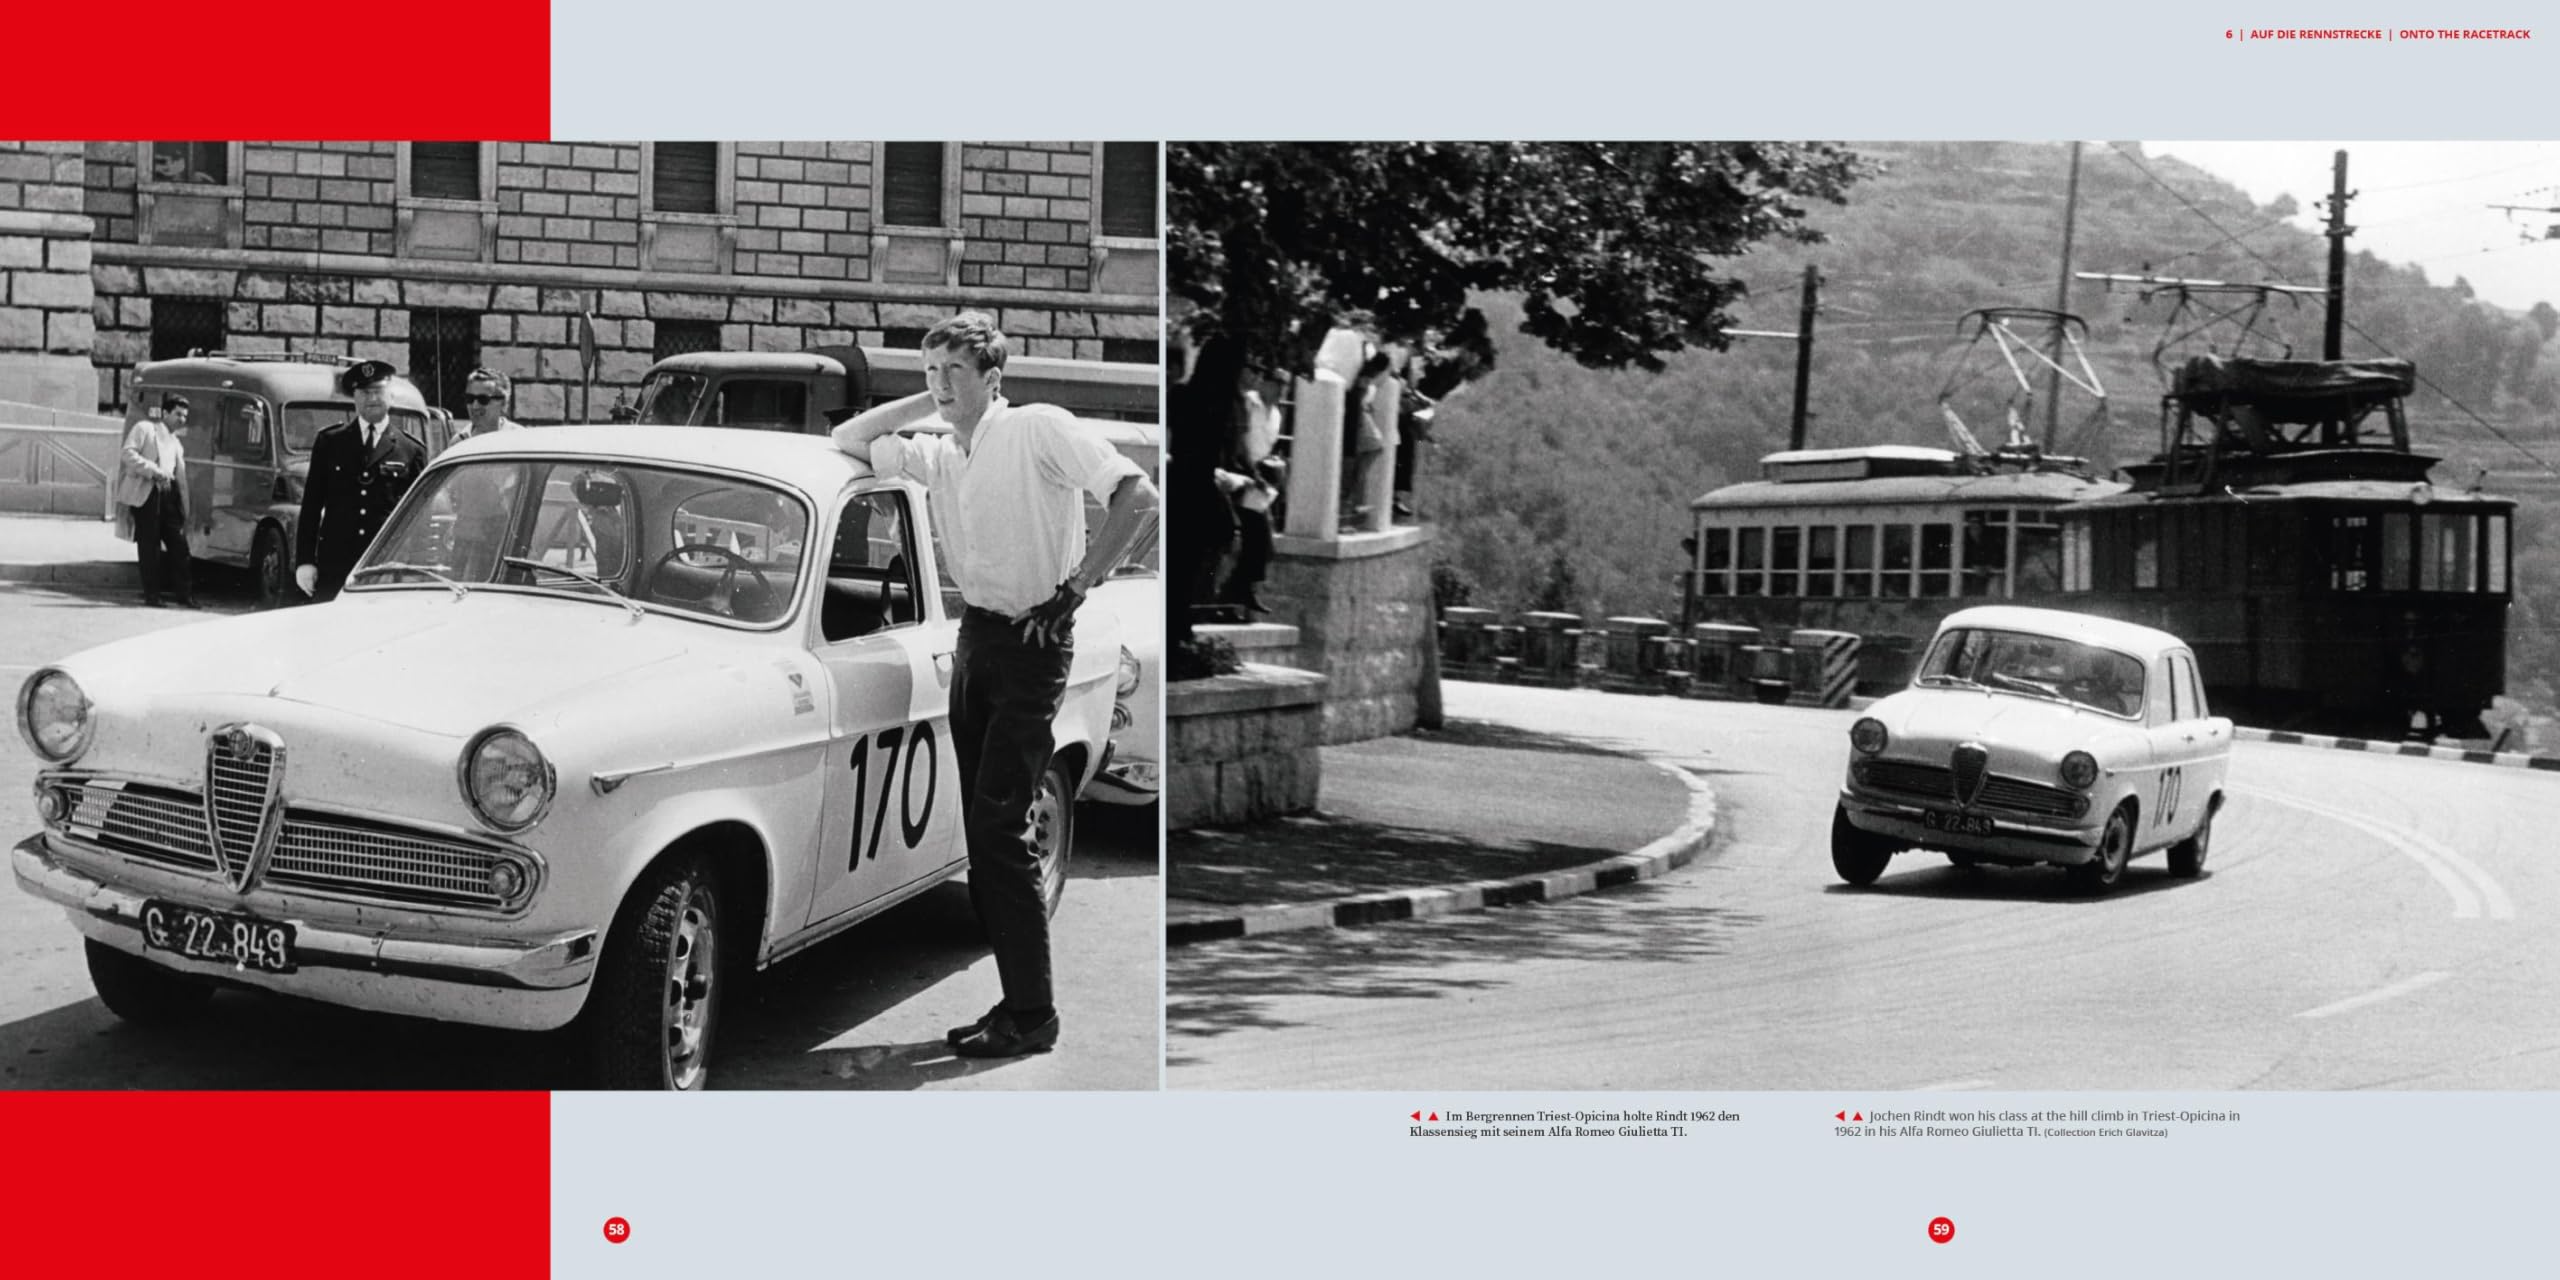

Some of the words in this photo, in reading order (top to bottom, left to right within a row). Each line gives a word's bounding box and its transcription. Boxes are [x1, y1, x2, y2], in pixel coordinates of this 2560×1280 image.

[849, 720, 937, 872] 170
[1926, 811, 1937, 829] G
[2152, 766, 2182, 828] 170
[146, 907, 169, 946] G
